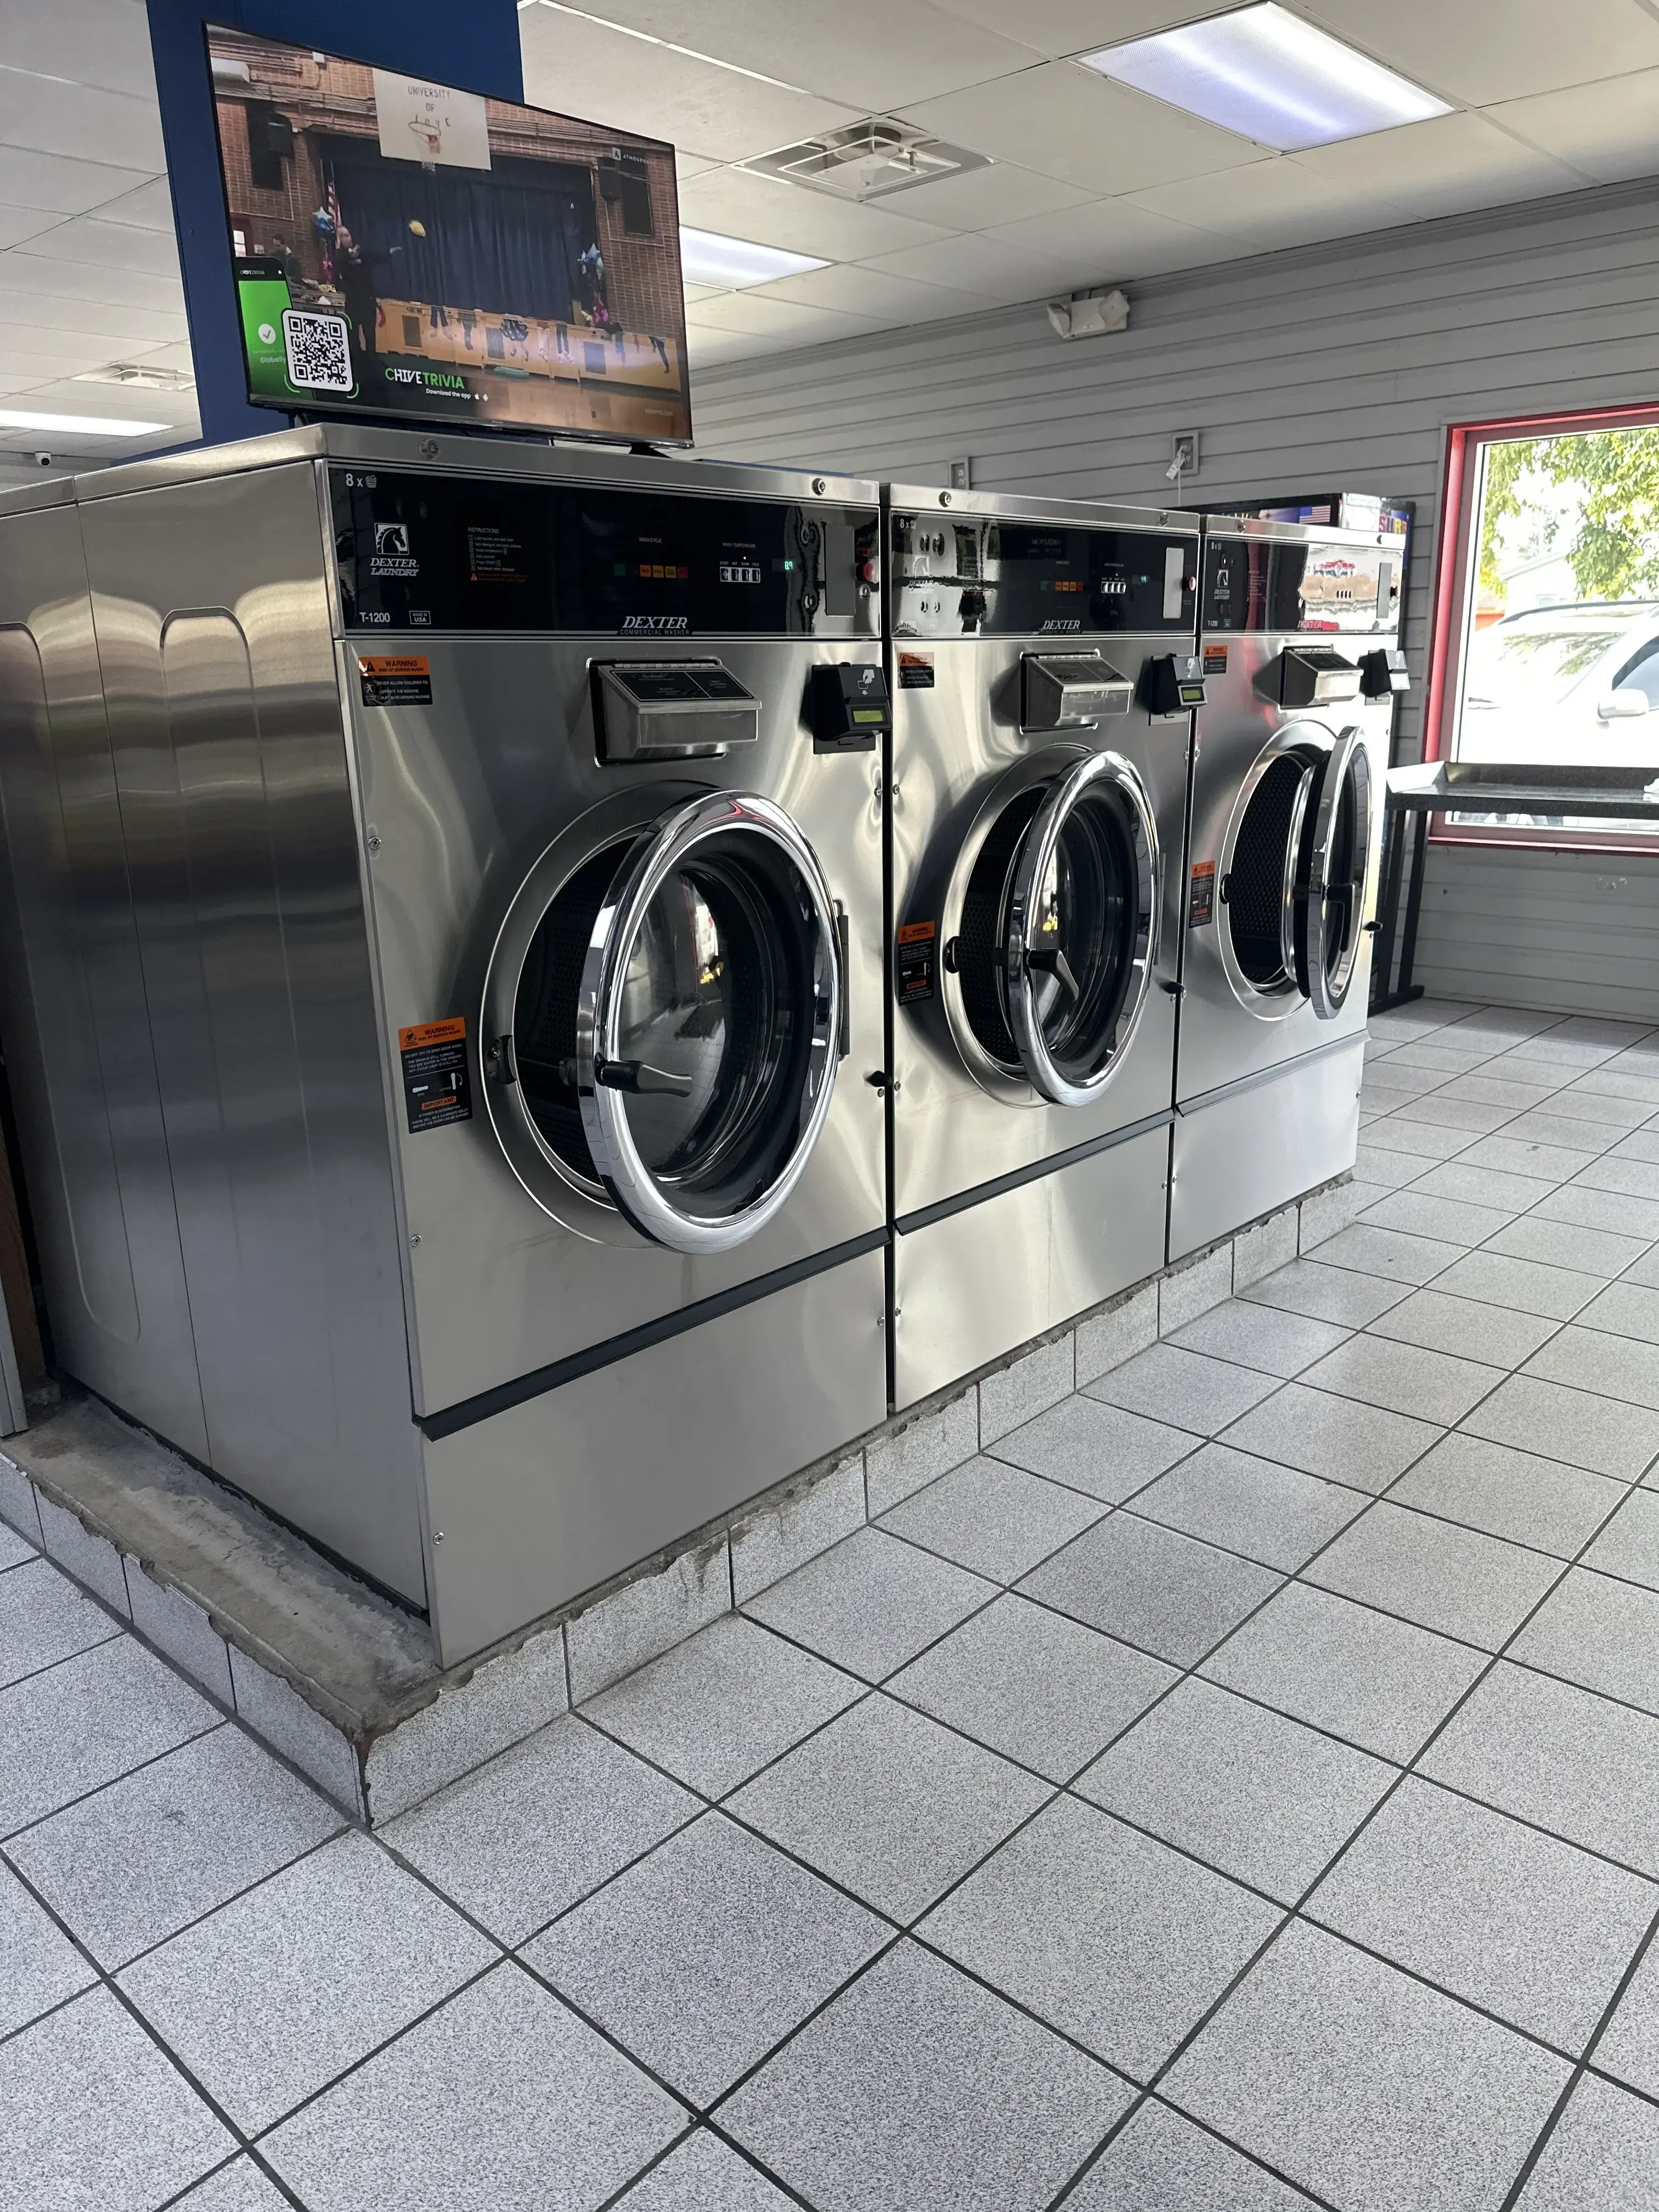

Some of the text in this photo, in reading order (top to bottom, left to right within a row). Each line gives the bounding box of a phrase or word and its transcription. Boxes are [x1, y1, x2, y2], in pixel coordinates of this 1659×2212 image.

[408, 86, 451, 99] UNIVERSITY
[426, 103, 436, 112] OF
[346, 473, 354, 487] 8
[900, 519, 904, 528] 8
[370, 557, 417, 567] DEXTER
[370, 568, 419, 577] LAUNDRY
[359, 612, 391, 623] T-1200
[622, 616, 687, 629] DEXTER
[1042, 620, 1080, 630] DEXTER
[425, 1024, 455, 1036] WARNING
[424, 1098, 454, 1108] IMPORTANT
